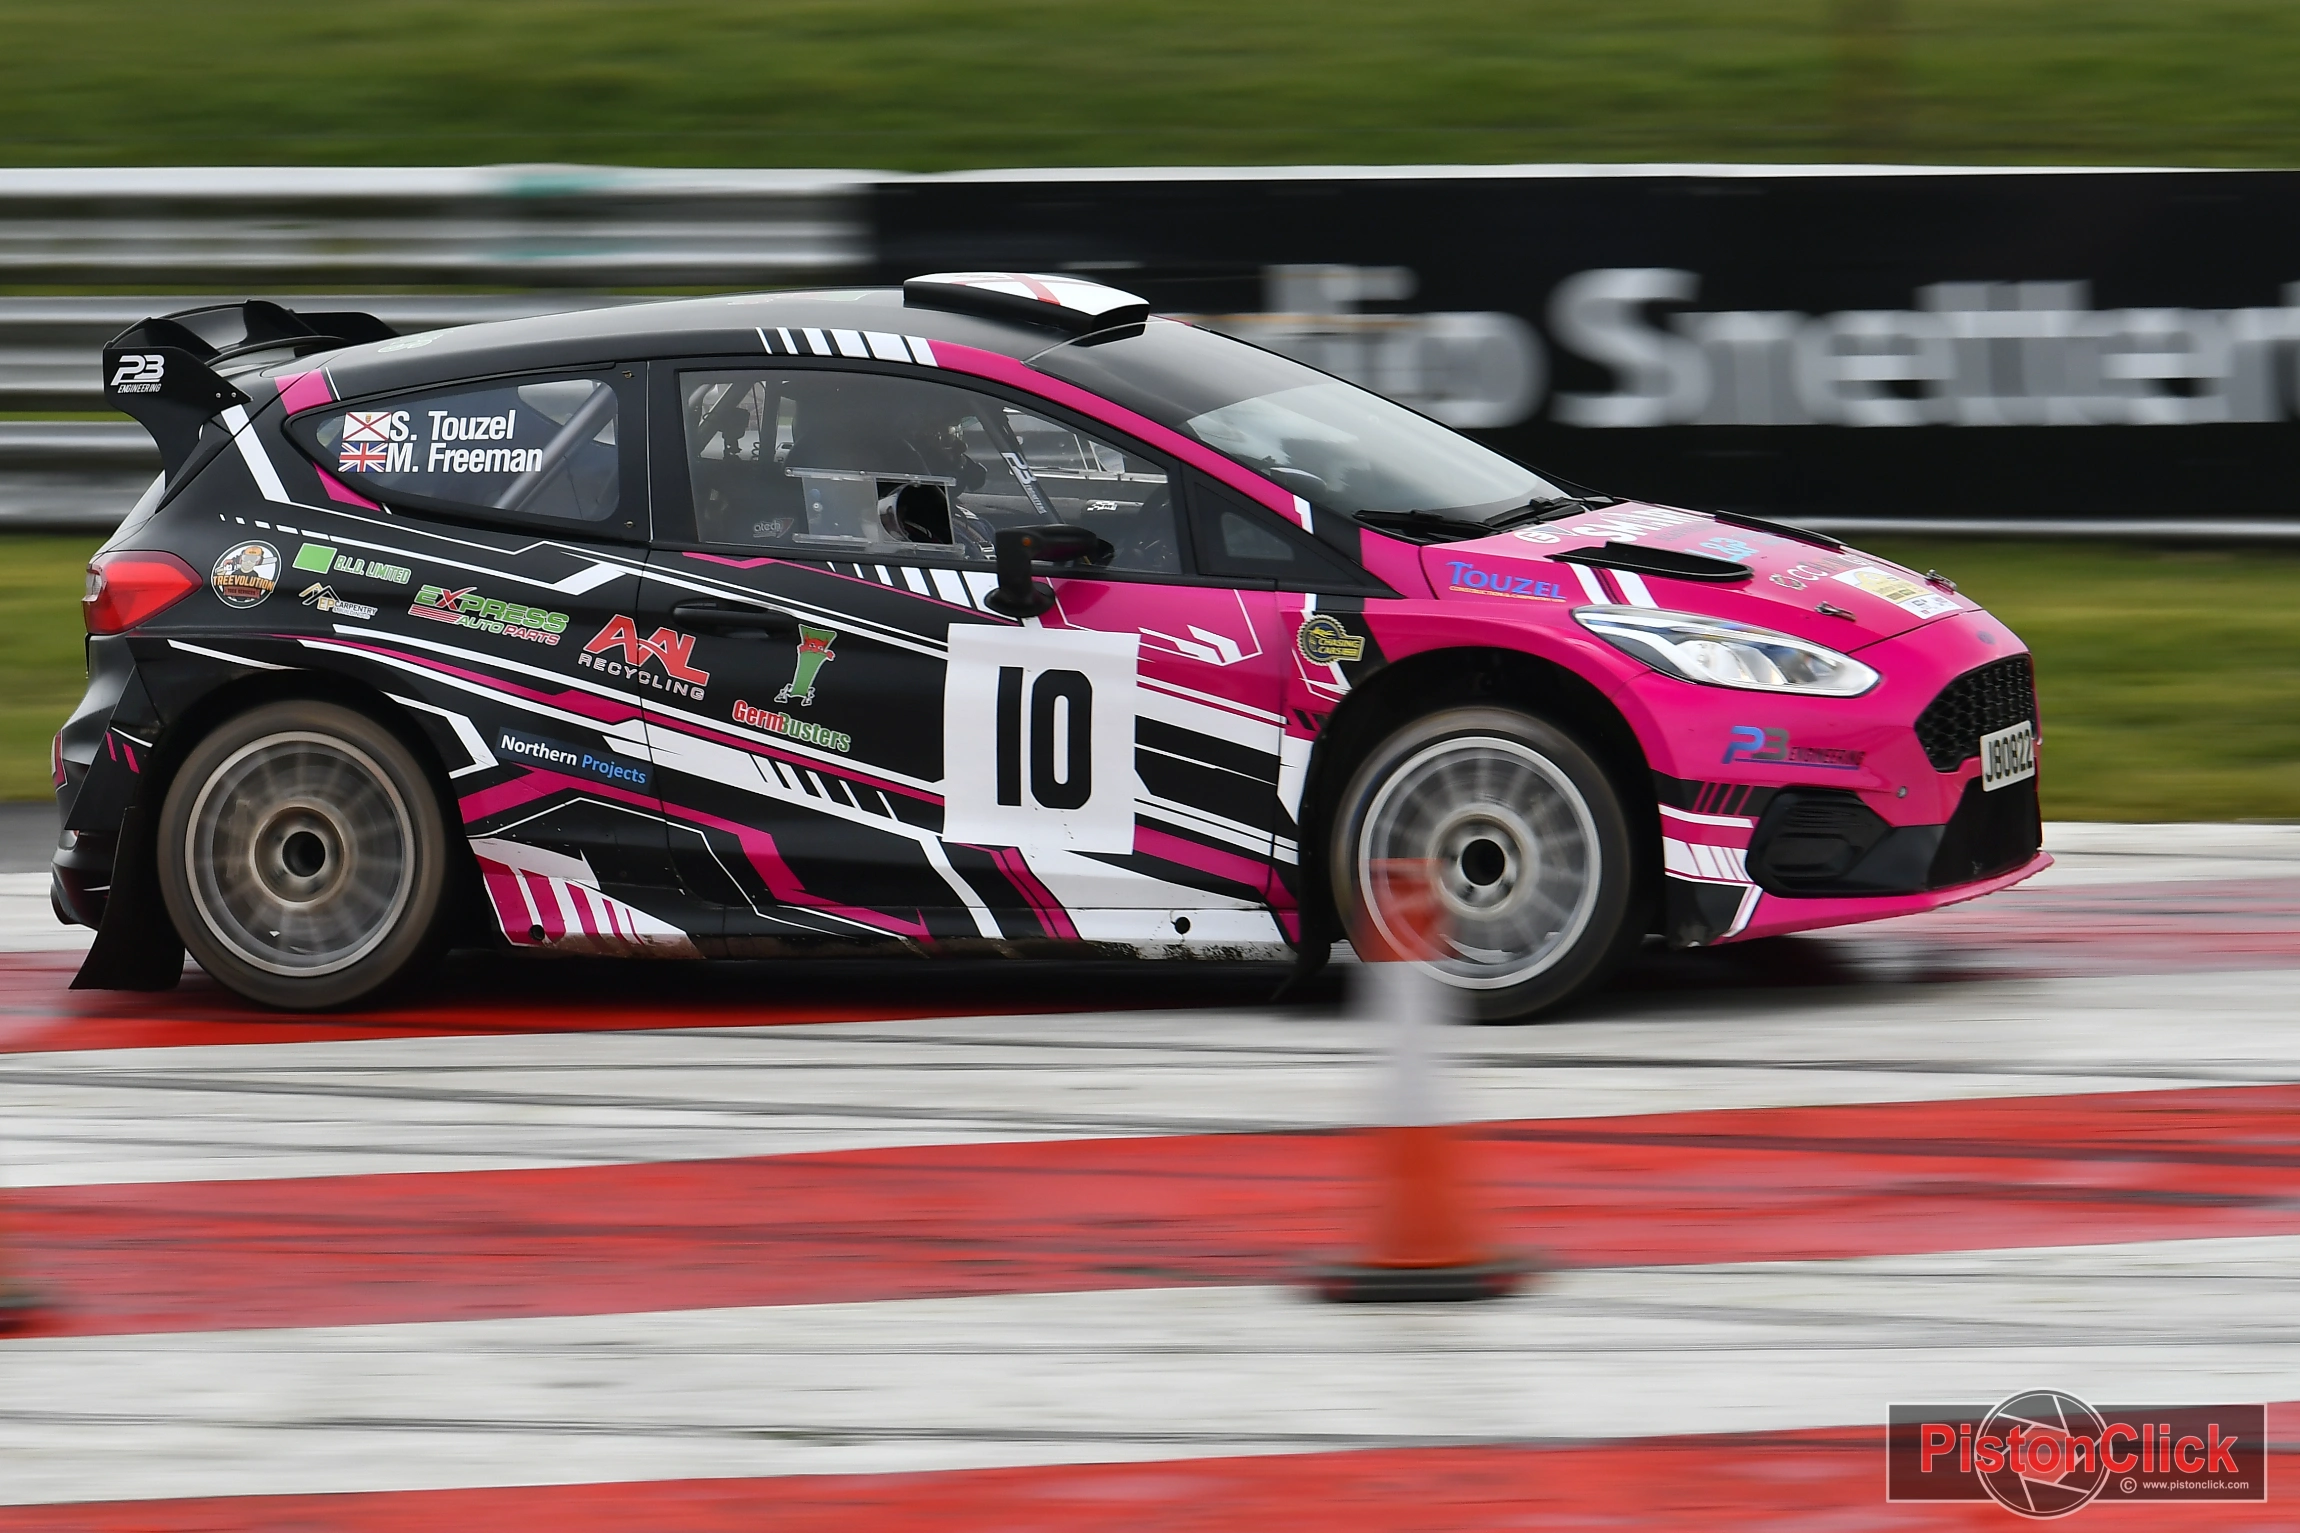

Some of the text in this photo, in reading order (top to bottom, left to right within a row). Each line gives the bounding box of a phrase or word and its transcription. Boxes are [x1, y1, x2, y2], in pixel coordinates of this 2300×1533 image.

[117, 383, 162, 394] ENGINEERING
[390, 409, 516, 442] S. Touzel
[385, 442, 543, 473] M. Freeman
[213, 575, 274, 591] TREEVOLUTION
[333, 555, 412, 585] B.L.D. LIMITED
[317, 596, 335, 611] EP
[334, 600, 378, 617] CARPENTRY
[414, 585, 570, 633] EXPRESS
[455, 615, 560, 646] AUTO PARTS
[578, 652, 705, 701] RECYCLING
[732, 699, 852, 752] GermBusters
[997, 665, 1092, 810] 10
[500, 734, 647, 784] Northern Projects
